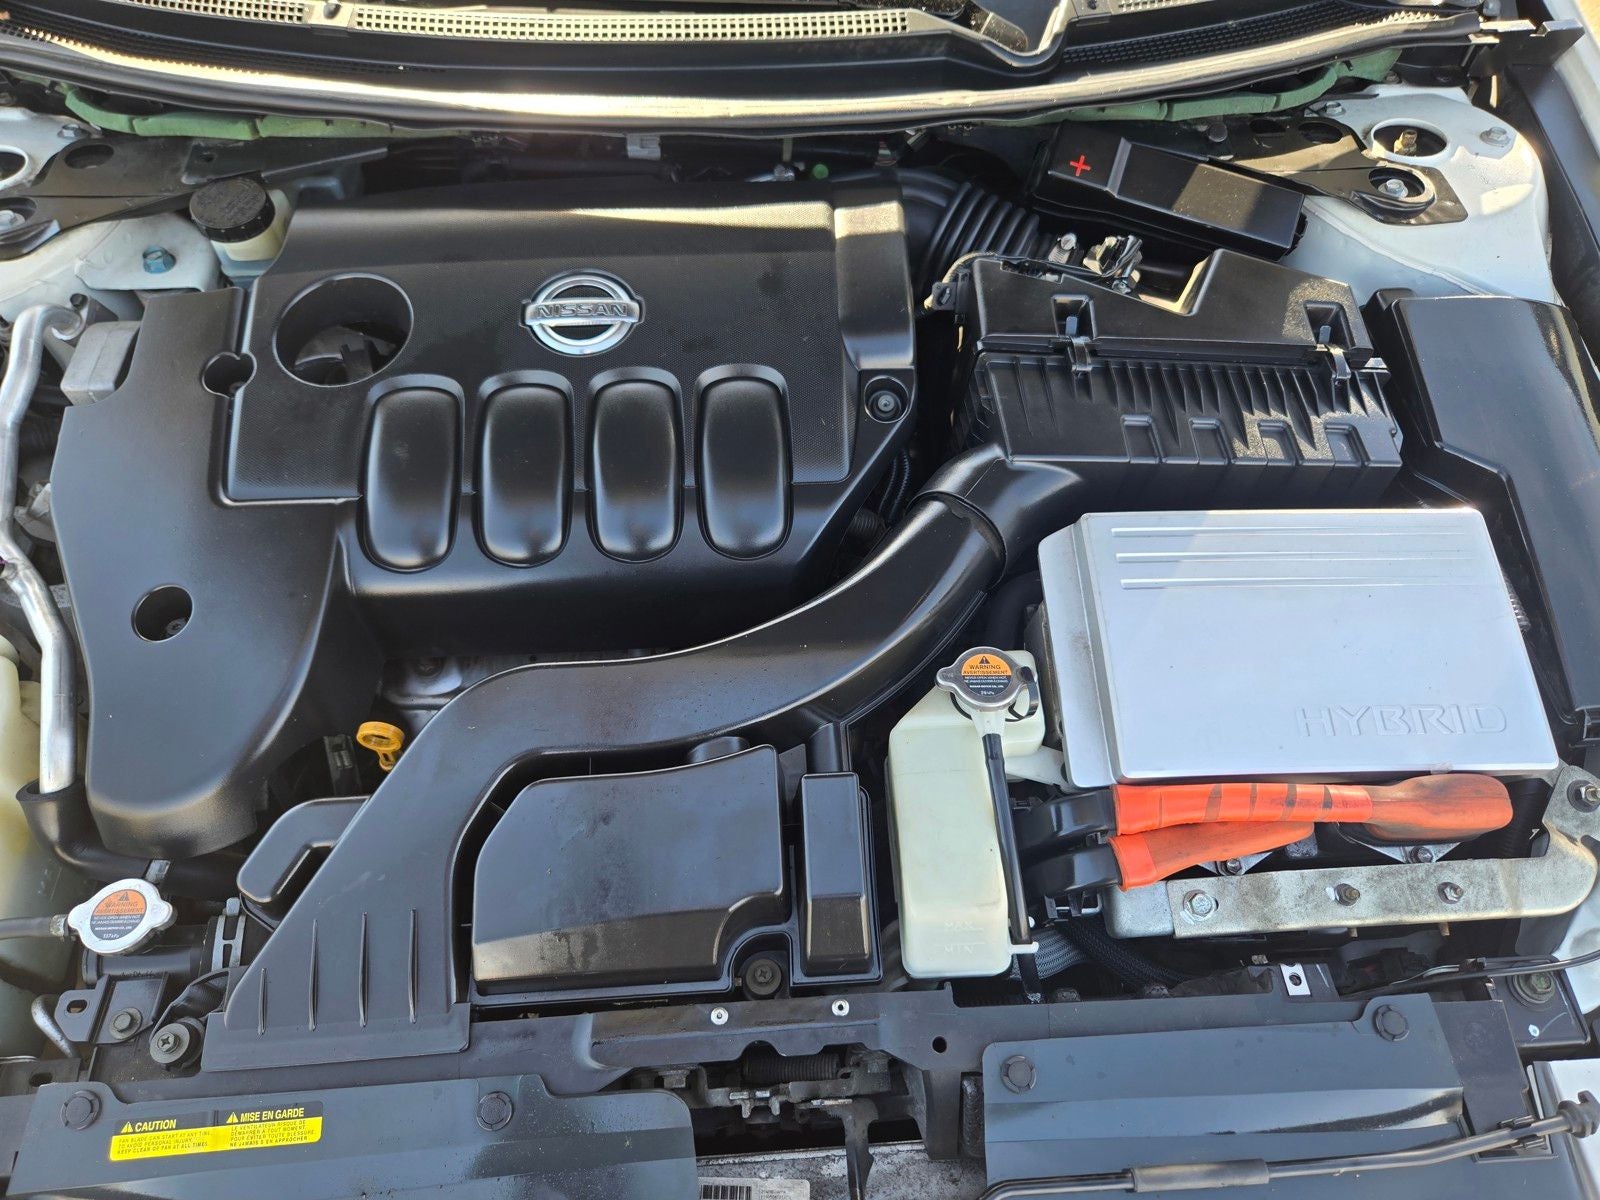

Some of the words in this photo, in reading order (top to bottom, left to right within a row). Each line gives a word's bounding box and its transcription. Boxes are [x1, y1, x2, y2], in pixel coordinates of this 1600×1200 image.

[537, 303, 628, 317] NISSAN
[1296, 703, 1508, 737] HYBRID
[240, 1112, 261, 1122] MISE
[262, 1110, 274, 1120] EN
[275, 1107, 305, 1119] GARDE
[134, 1119, 177, 1132] CAUTION
